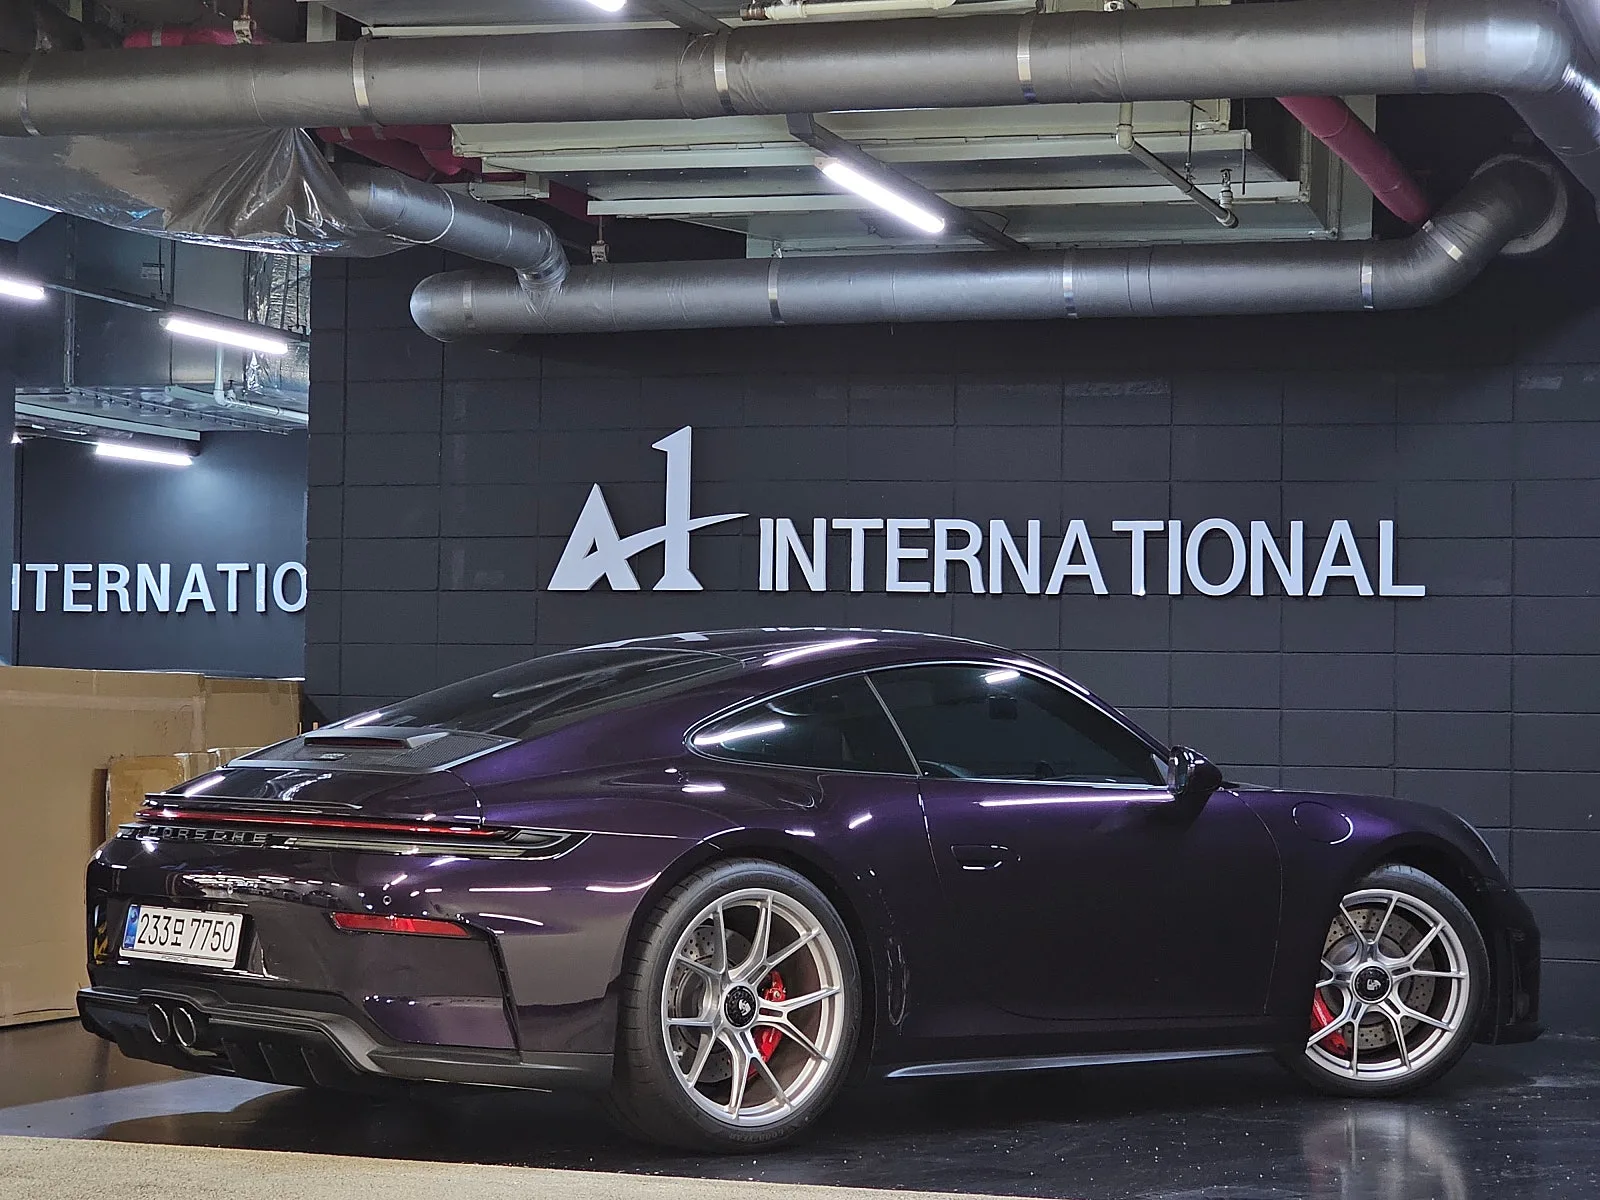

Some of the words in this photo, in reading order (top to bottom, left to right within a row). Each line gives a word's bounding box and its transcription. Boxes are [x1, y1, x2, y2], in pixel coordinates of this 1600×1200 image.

[547, 425, 750, 591] A1
[758, 518, 1426, 597] INTERNATIONAL
[147, 826, 268, 844] PORSCHE
[189, 918, 235, 953] 7750
